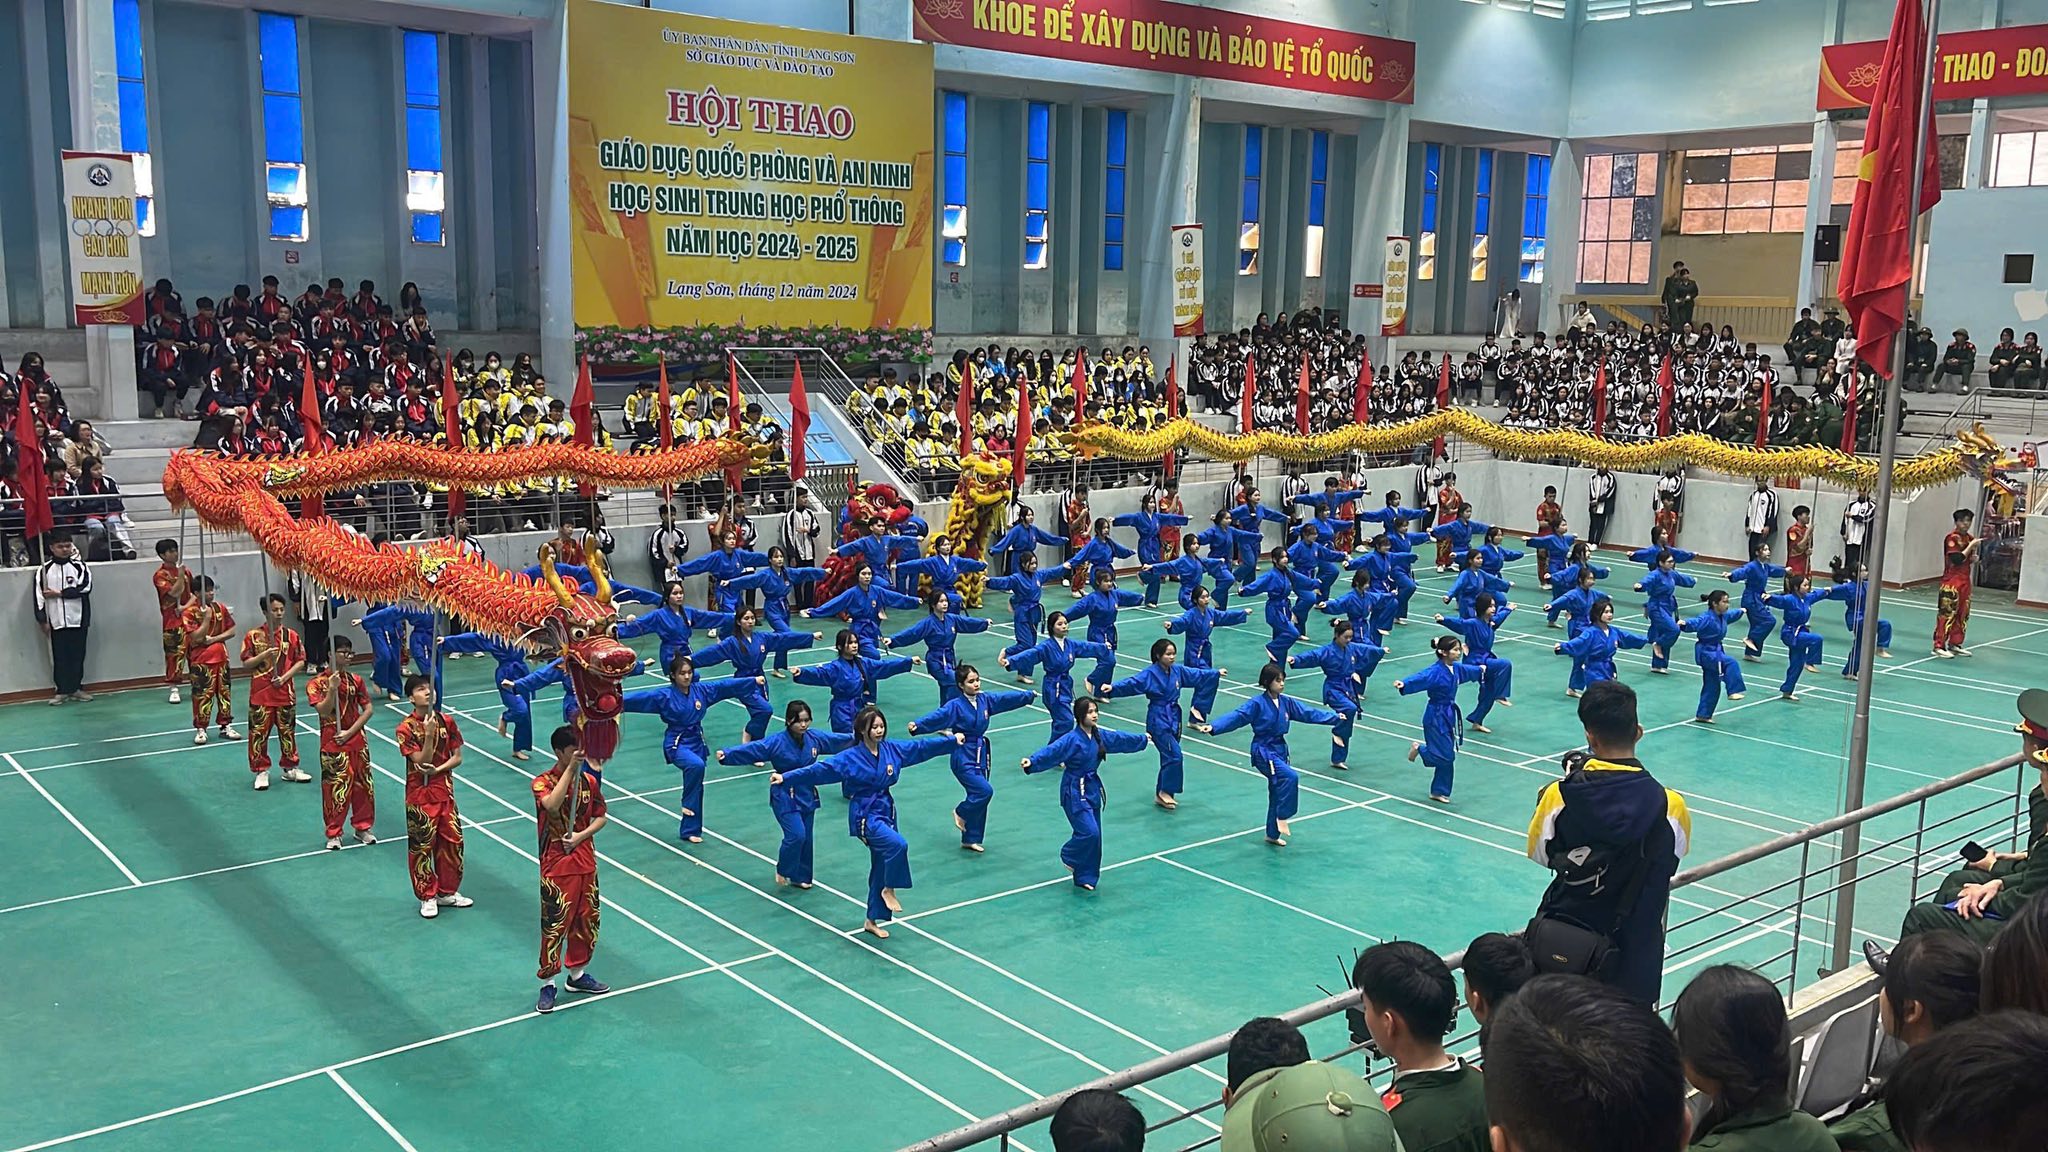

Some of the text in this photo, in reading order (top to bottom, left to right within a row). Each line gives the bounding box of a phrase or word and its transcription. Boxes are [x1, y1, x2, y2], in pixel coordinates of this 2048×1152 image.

[683, 33, 707, 46] BAN
[709, 35, 742, 51] NHÂN
[745, 39, 769, 54] DÂN
[833, 52, 856, 64] SƠN
[1044, 0, 1074, 42] ĐỂ
[1081, 9, 1125, 48] XÂY
[1132, 20, 1190, 60] DỰNG
[1196, 26, 1222, 62] VÀ
[1228, 25, 1267, 68] BẢO
[1273, 39, 1295, 78] VỆ
[1300, 38, 1324, 76] TỔ
[1327, 45, 1374, 84] QUỐC
[704, 52, 735, 66] GIÁO
[738, 56, 762, 71] DỤC
[764, 57, 780, 71] VÀ
[783, 59, 808, 74] ĐÀO
[810, 64, 834, 78] TẠO
[1943, 51, 1996, 83] THAO
[2016, 47, 2048, 77] ĐO
[667, 86, 853, 137] HỘI THAO
[600, 138, 911, 188] GIÁO DỤC QUỐC PHÒNG VÀ AN NINH
[72, 196, 109, 220] NHANH
[610, 183, 904, 224] HỌC SINH TRUNG HỌC PHỔ THÔNG
[82, 233, 104, 257] CAO
[667, 224, 710, 254] NĂM
[716, 230, 752, 260] HỌC
[757, 232, 799, 257] 2024
[816, 235, 857, 259] 2025
[80, 271, 113, 299] MẠNH
[667, 281, 857, 299] Lạng Sơn, tháng 12 năm 2024
